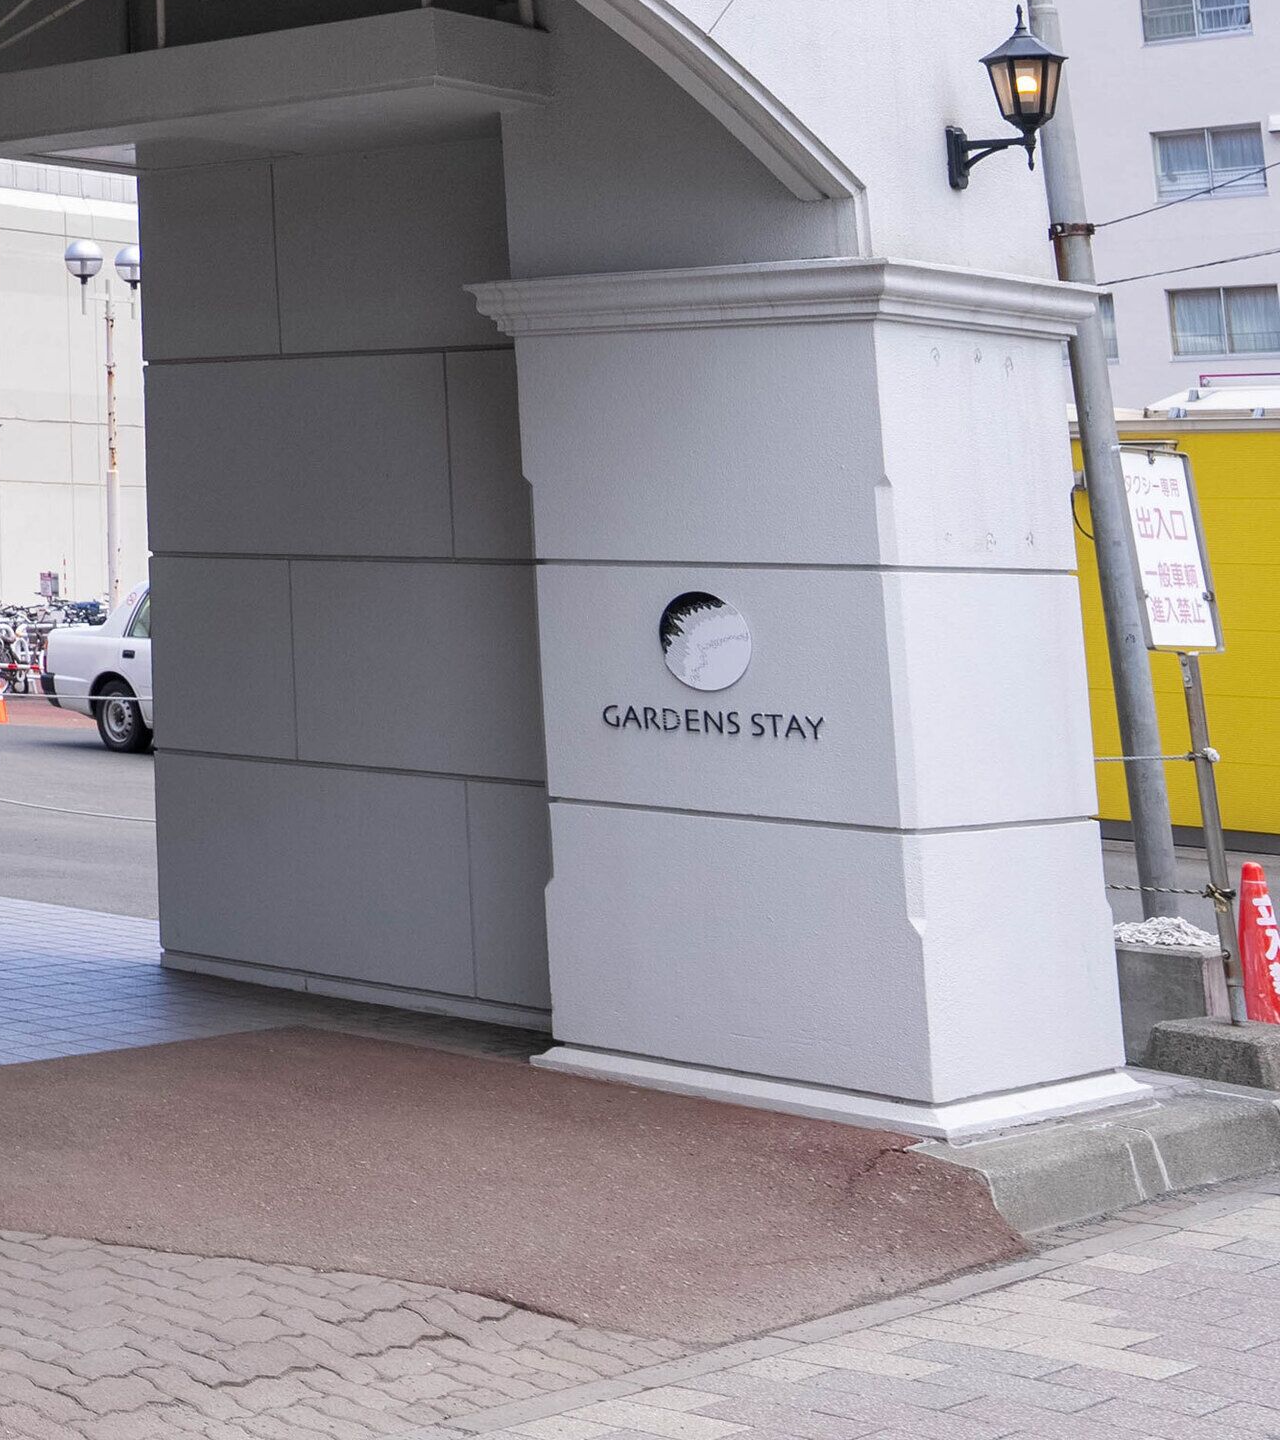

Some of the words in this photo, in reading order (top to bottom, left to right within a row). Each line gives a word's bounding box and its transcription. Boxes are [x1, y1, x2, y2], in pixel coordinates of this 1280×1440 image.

[1136, 506, 1188, 541] 出入口
[1151, 597, 1206, 625] 進入禁止
[602, 704, 741, 736] GARDENS
[751, 713, 825, 741] STAY
